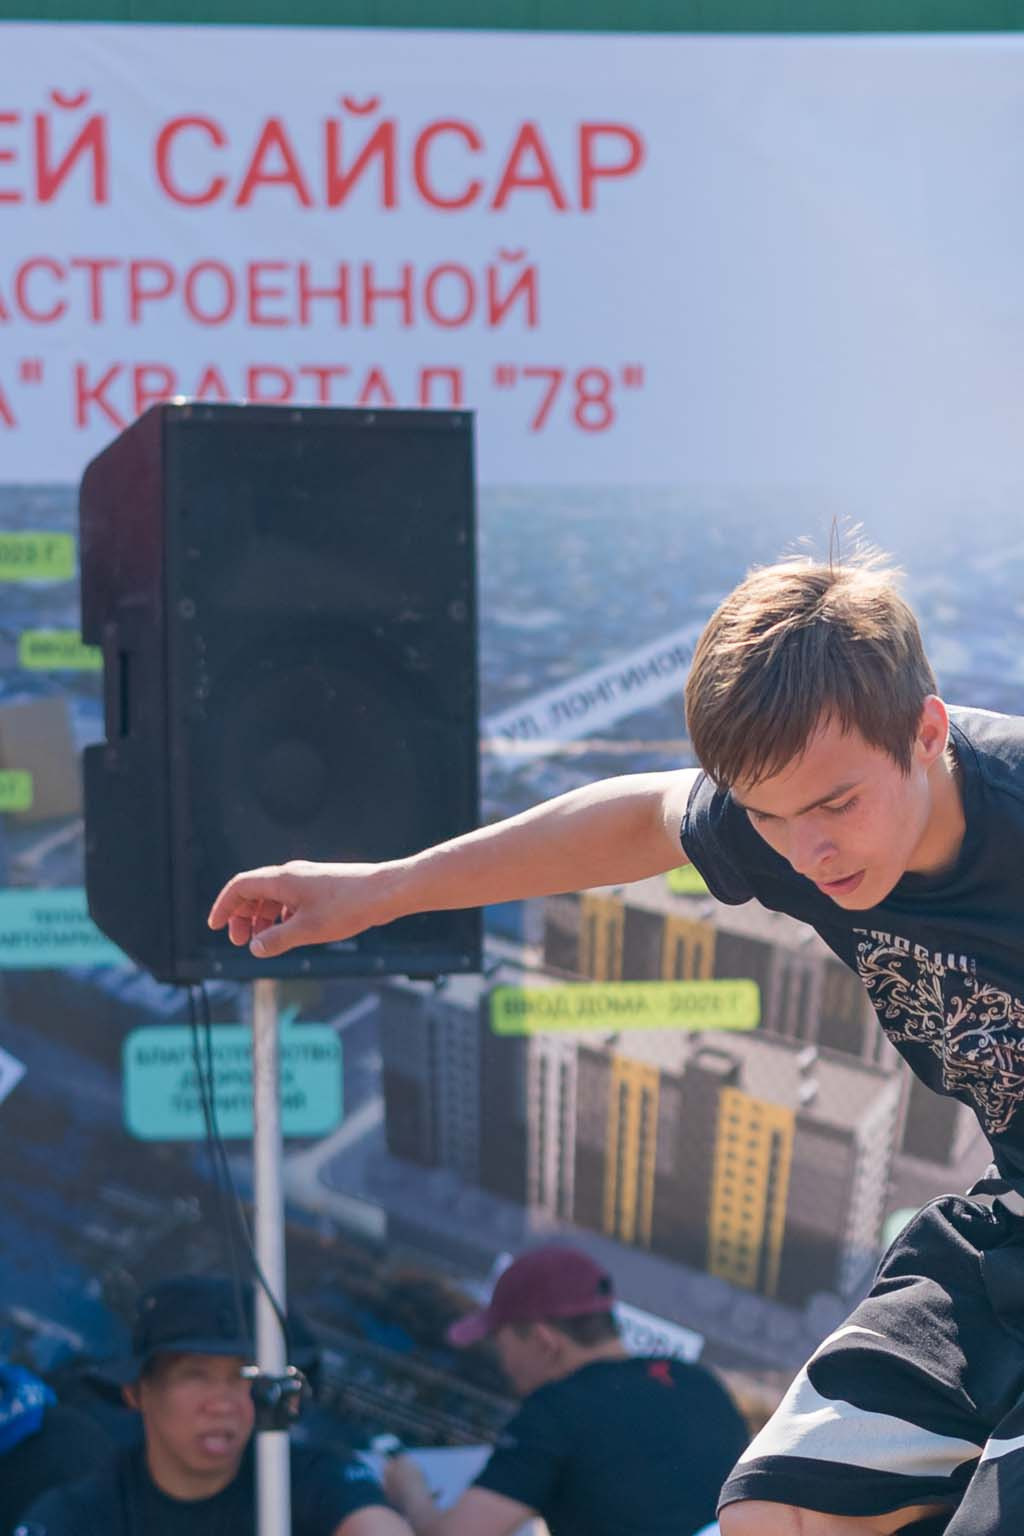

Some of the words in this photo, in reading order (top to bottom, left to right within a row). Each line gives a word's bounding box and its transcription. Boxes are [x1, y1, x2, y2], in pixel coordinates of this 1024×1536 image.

[152, 95, 647, 212] САЙСАР
[0, 249, 541, 330] СТРОЕННОЙ
[492, 364, 646, 434] "78"
